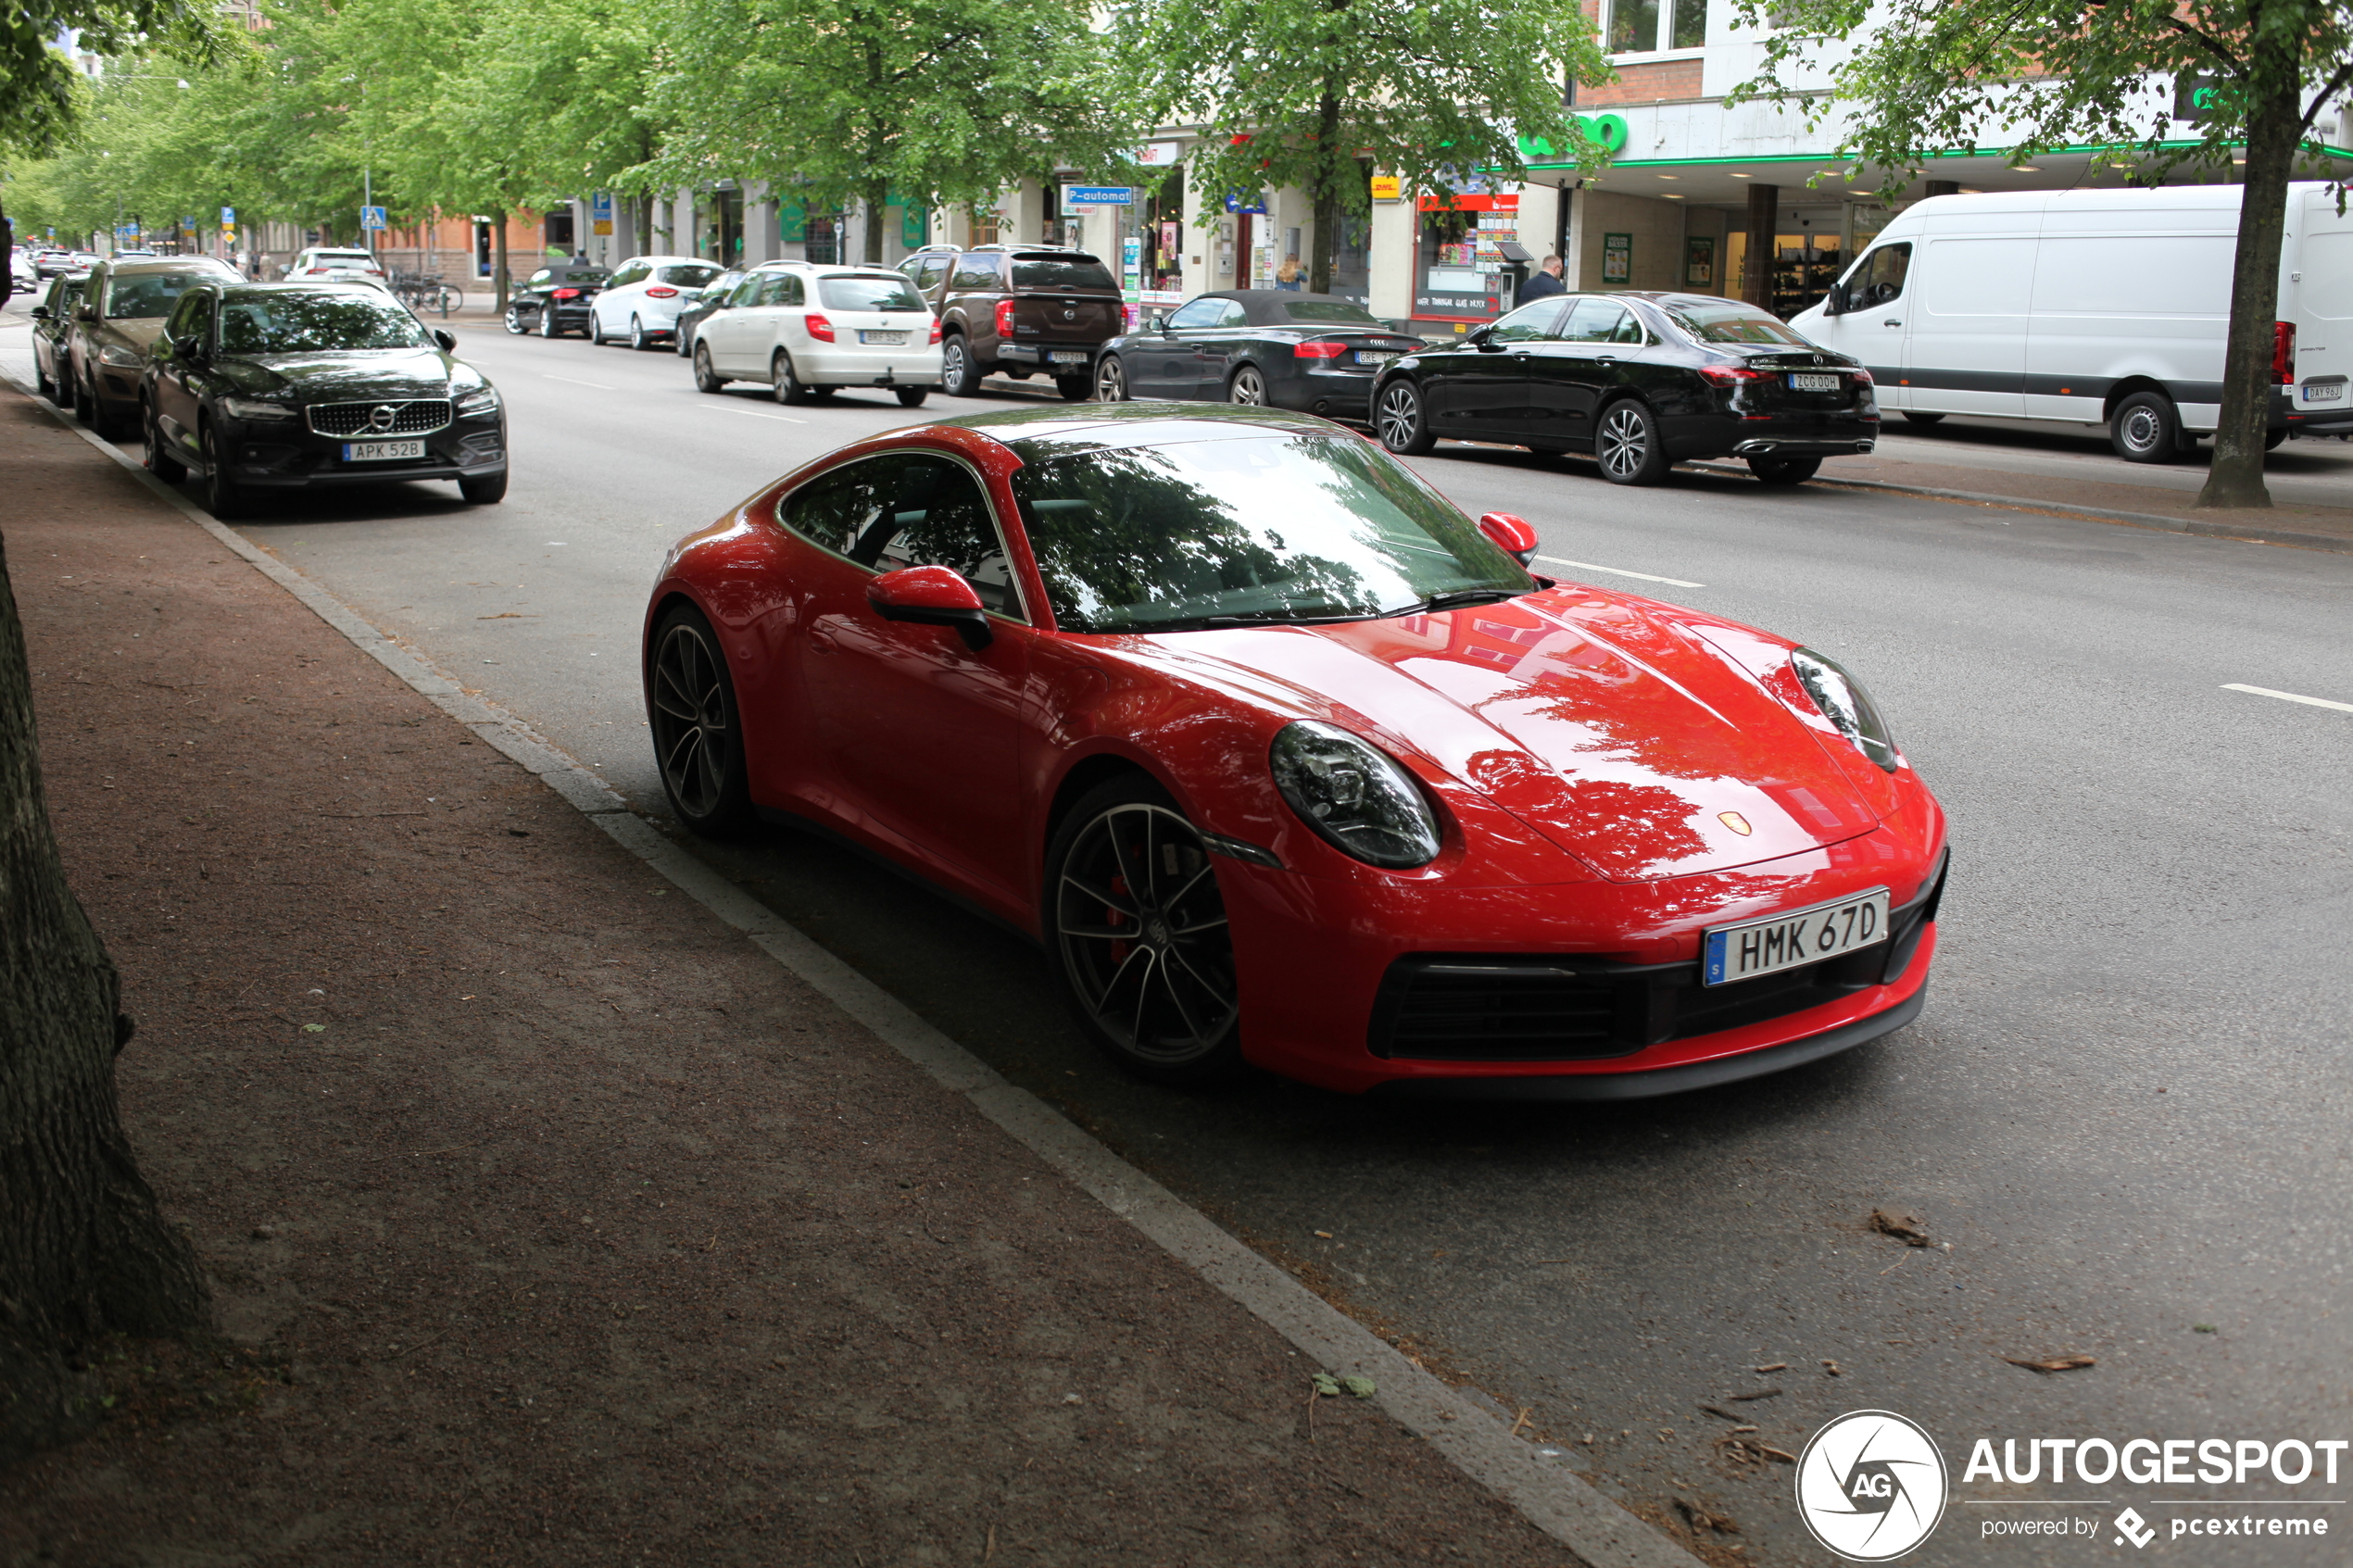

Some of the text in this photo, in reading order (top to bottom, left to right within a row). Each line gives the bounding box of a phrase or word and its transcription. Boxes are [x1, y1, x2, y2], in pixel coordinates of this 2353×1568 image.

[1069, 190, 1130, 201] P-automat
[1416, 297, 1429, 306] KAFFE
[1431, 297, 1453, 307] TIDNINGAR
[1469, 299, 1486, 308] DRYCK
[1070, 352, 1085, 361] 268
[1360, 352, 1377, 362] GRE
[1797, 375, 1816, 387] ZCG
[2310, 386, 2339, 398] DAY 96J
[356, 443, 419, 458] APK 52B
[1711, 901, 1877, 975] S HMK 67D
